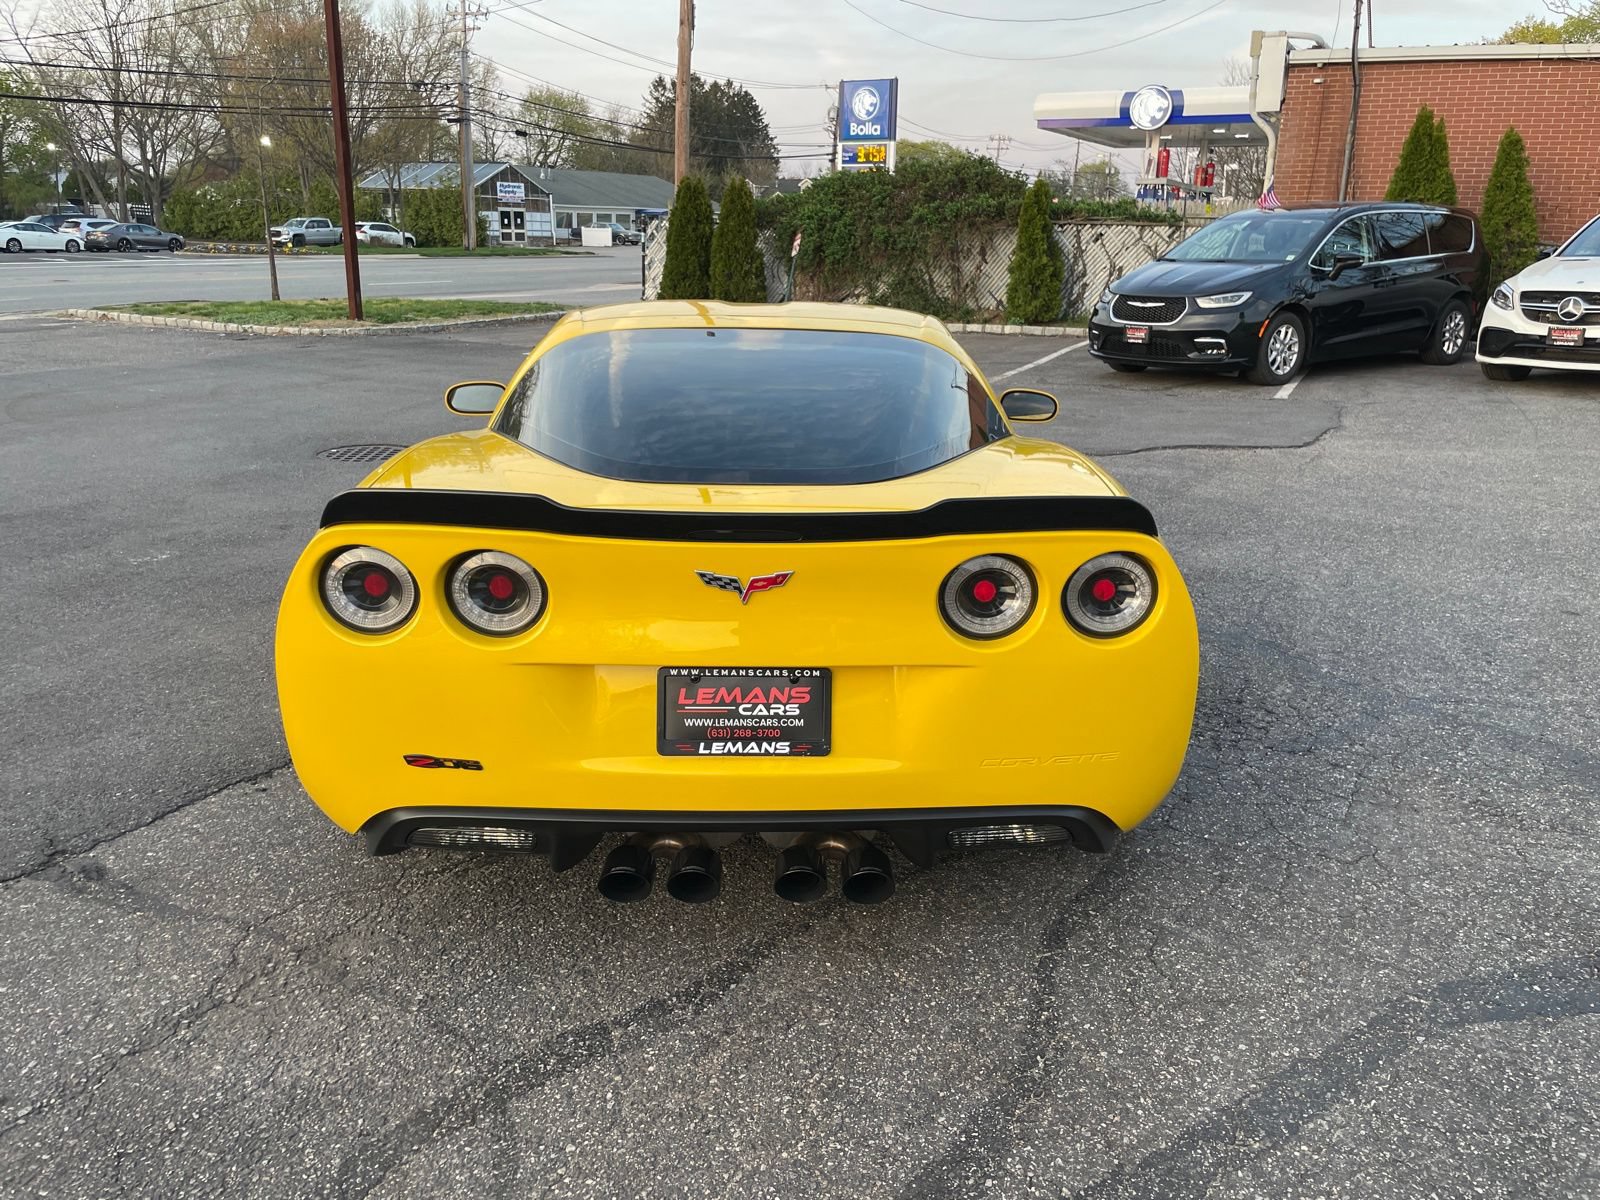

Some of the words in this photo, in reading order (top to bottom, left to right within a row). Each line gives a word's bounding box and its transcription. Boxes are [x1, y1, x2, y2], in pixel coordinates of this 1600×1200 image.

[850, 121, 881, 136] Bolla
[669, 668, 821, 678] WWW.LEMANSCARS.COM
[677, 686, 812, 705] LEMANS
[738, 703, 801, 716] CARS
[684, 718, 804, 727] WWW.LEMANSCARS.COM
[707, 727, 731, 739] (631)
[733, 728, 781, 738] 268-3700
[698, 741, 791, 754] LEMANS
[979, 751, 1121, 768] CORVETTE
